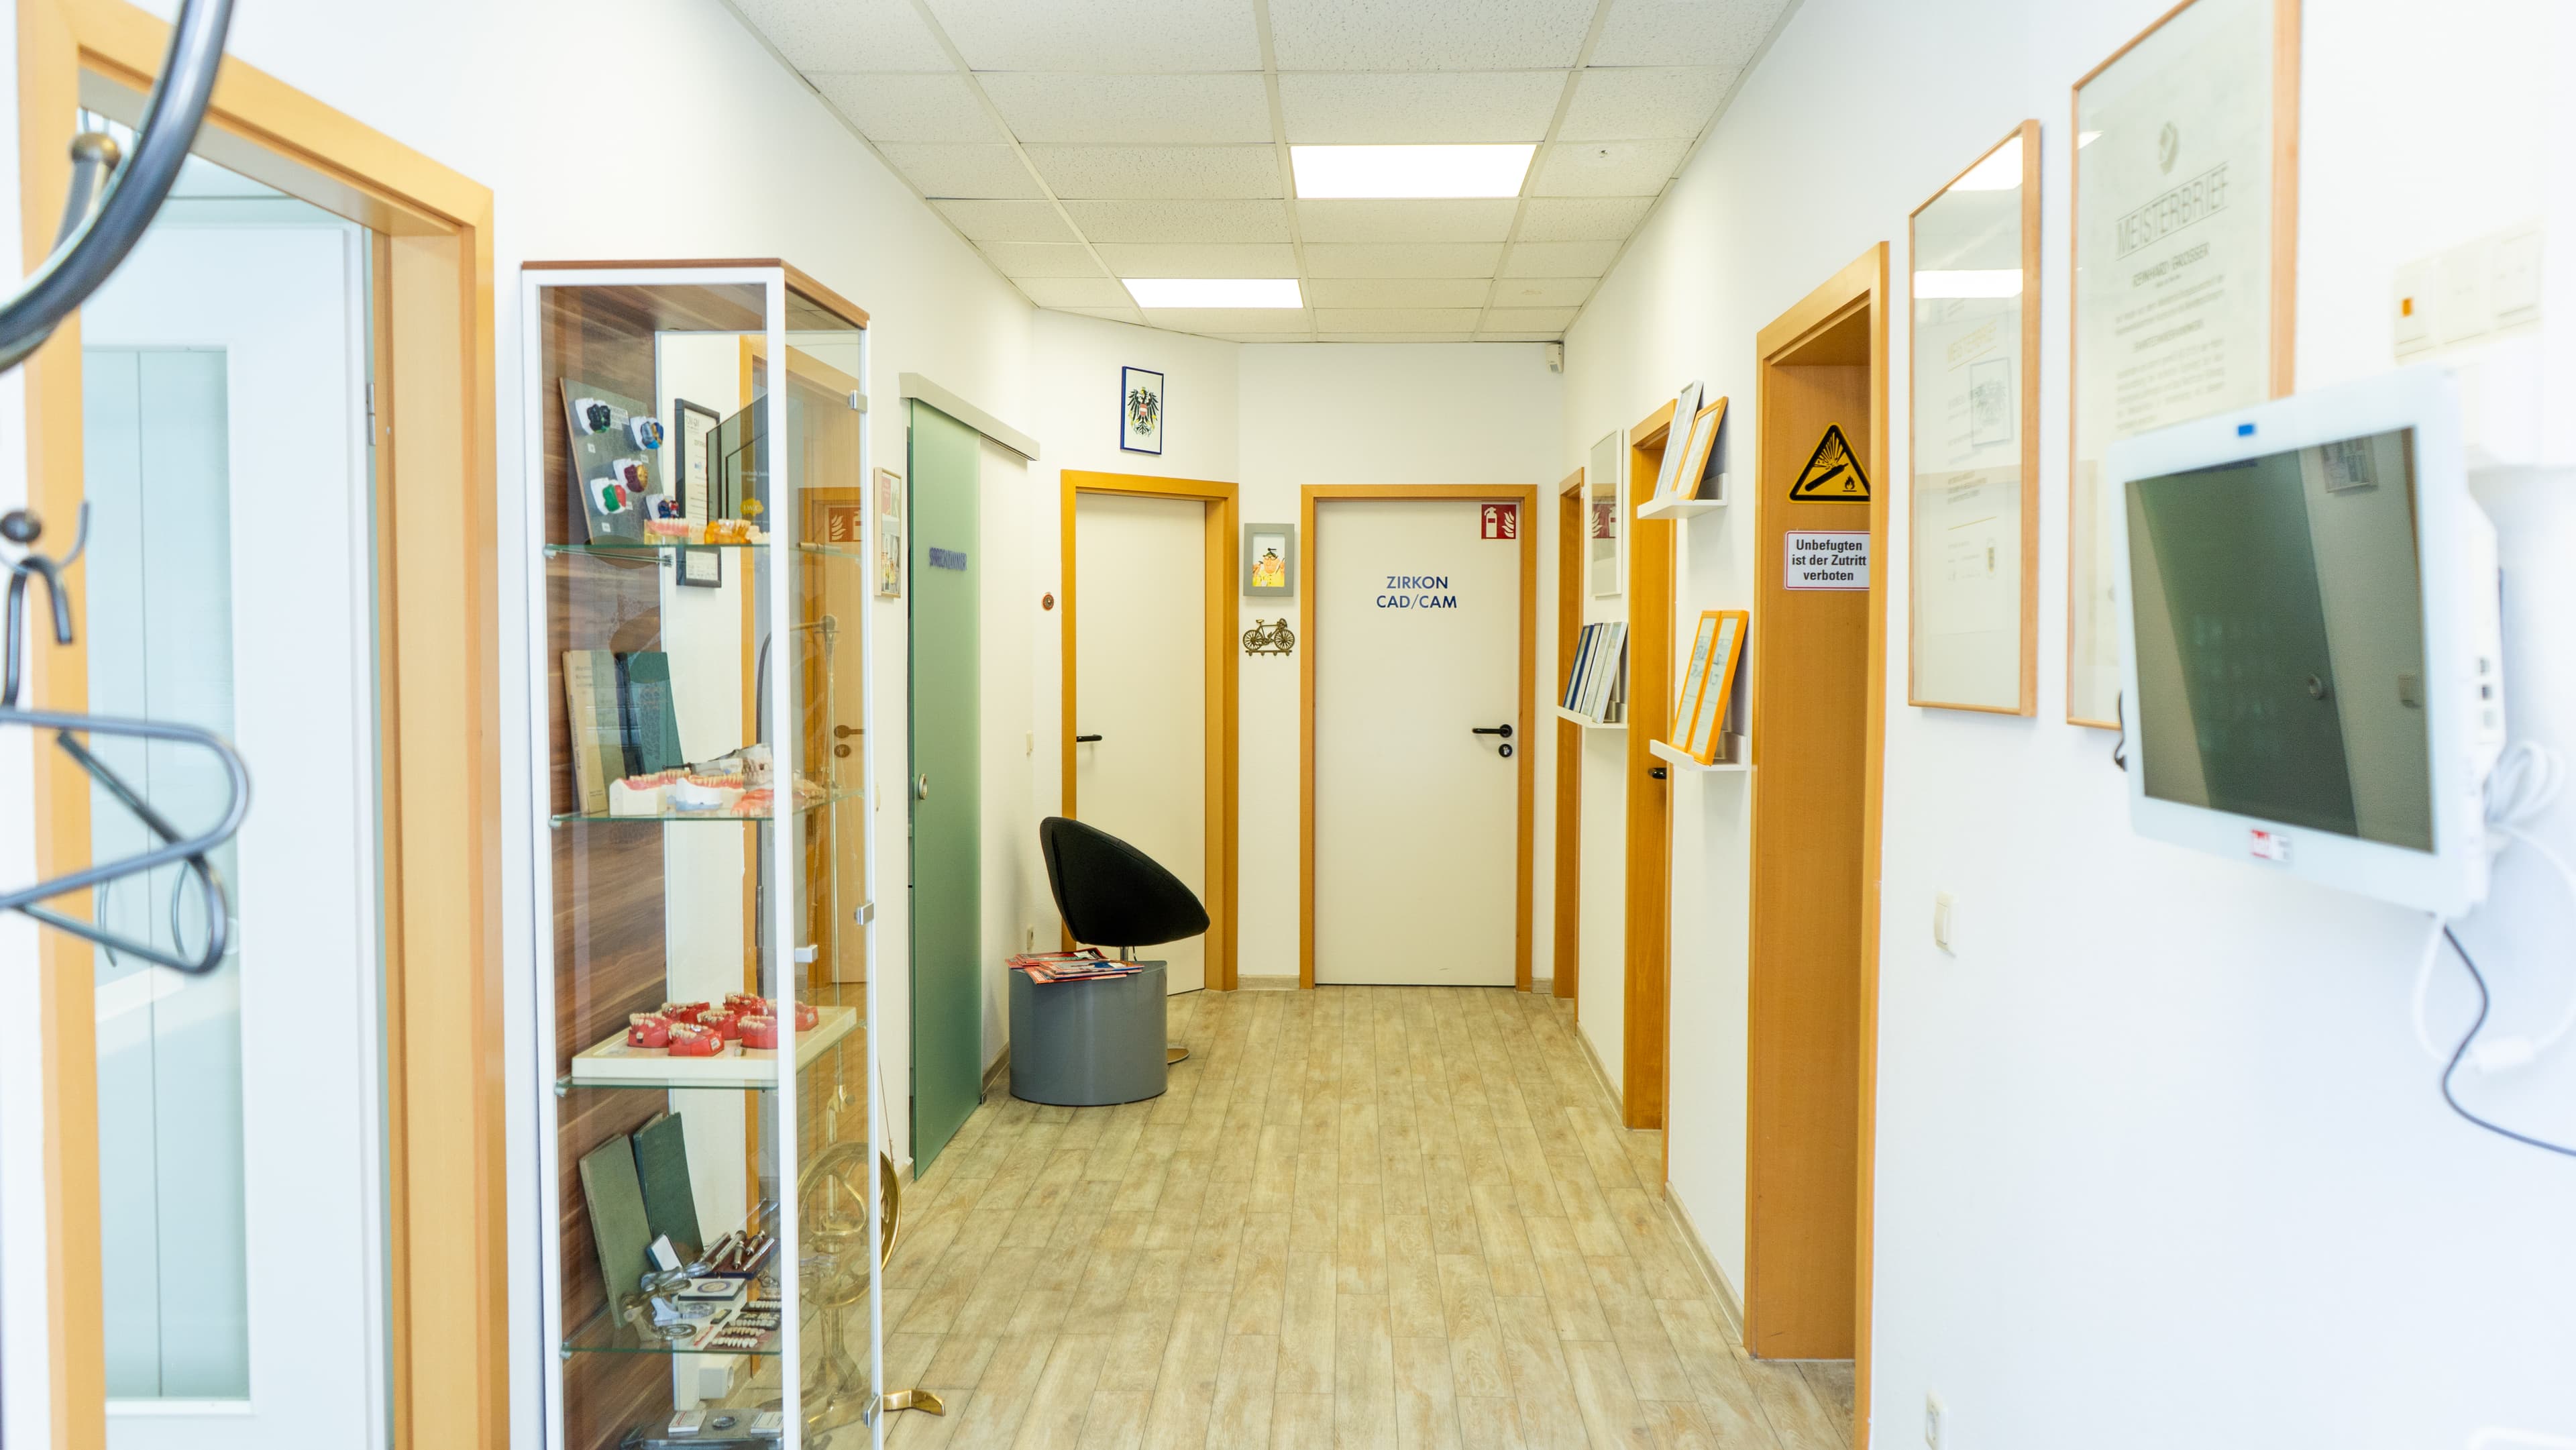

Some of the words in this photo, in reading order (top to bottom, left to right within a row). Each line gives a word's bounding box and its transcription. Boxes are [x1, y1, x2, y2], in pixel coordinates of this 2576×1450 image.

[2117, 165, 2229, 256] MEISTERBRIEF
[1796, 539, 1862, 553] Unbefugten
[1792, 554, 1806, 565] ist
[1809, 554, 1828, 565] der
[1831, 554, 1866, 565] Zutritt
[1803, 569, 1854, 580] verboten
[1387, 576, 1448, 589] ZIRKON
[1377, 594, 1457, 609] CAD/CAM
